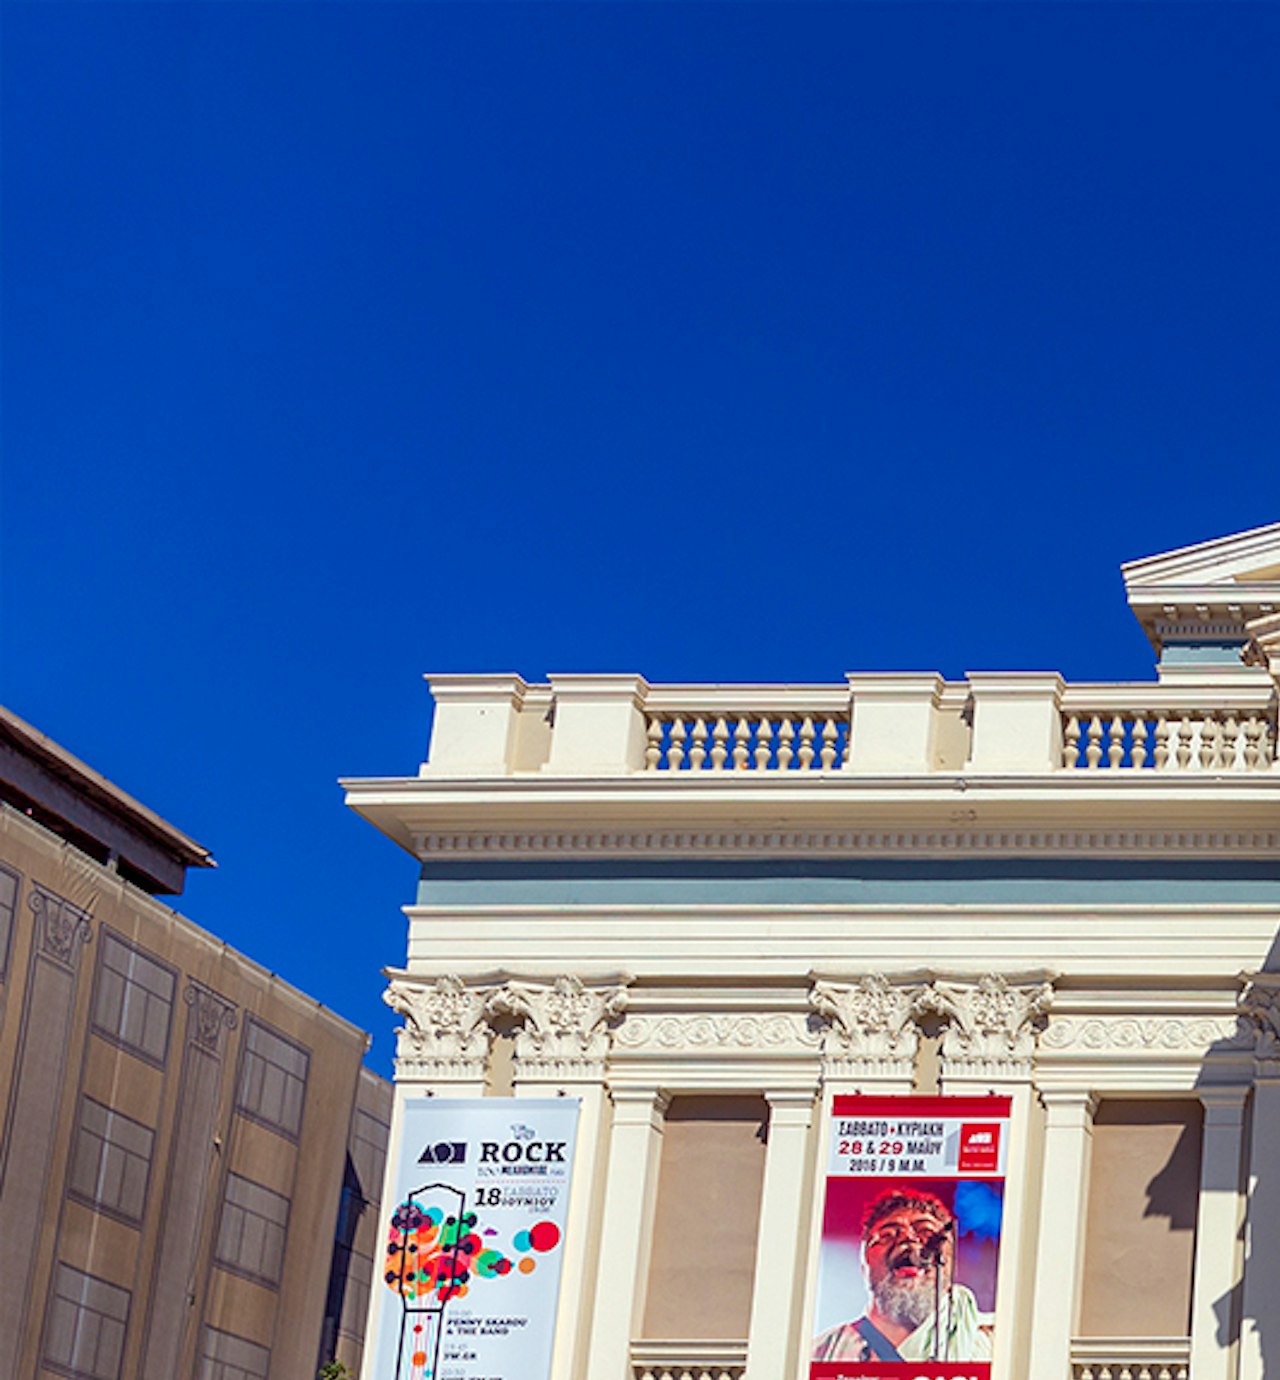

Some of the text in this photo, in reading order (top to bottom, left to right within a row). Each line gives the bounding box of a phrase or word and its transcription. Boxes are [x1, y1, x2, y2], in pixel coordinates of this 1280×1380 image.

[839, 1121, 944, 1137] ΣΑΒΒΑΤΟ ΚΥΡΙΑΚΗ
[479, 1142, 567, 1163] ROCK
[838, 1141, 862, 1155] 28
[865, 1141, 875, 1155] &
[879, 1141, 904, 1155] 29
[849, 1159, 876, 1172] 2016
[475, 1188, 501, 1206] 18
[480, 1327, 509, 1335] BAND
